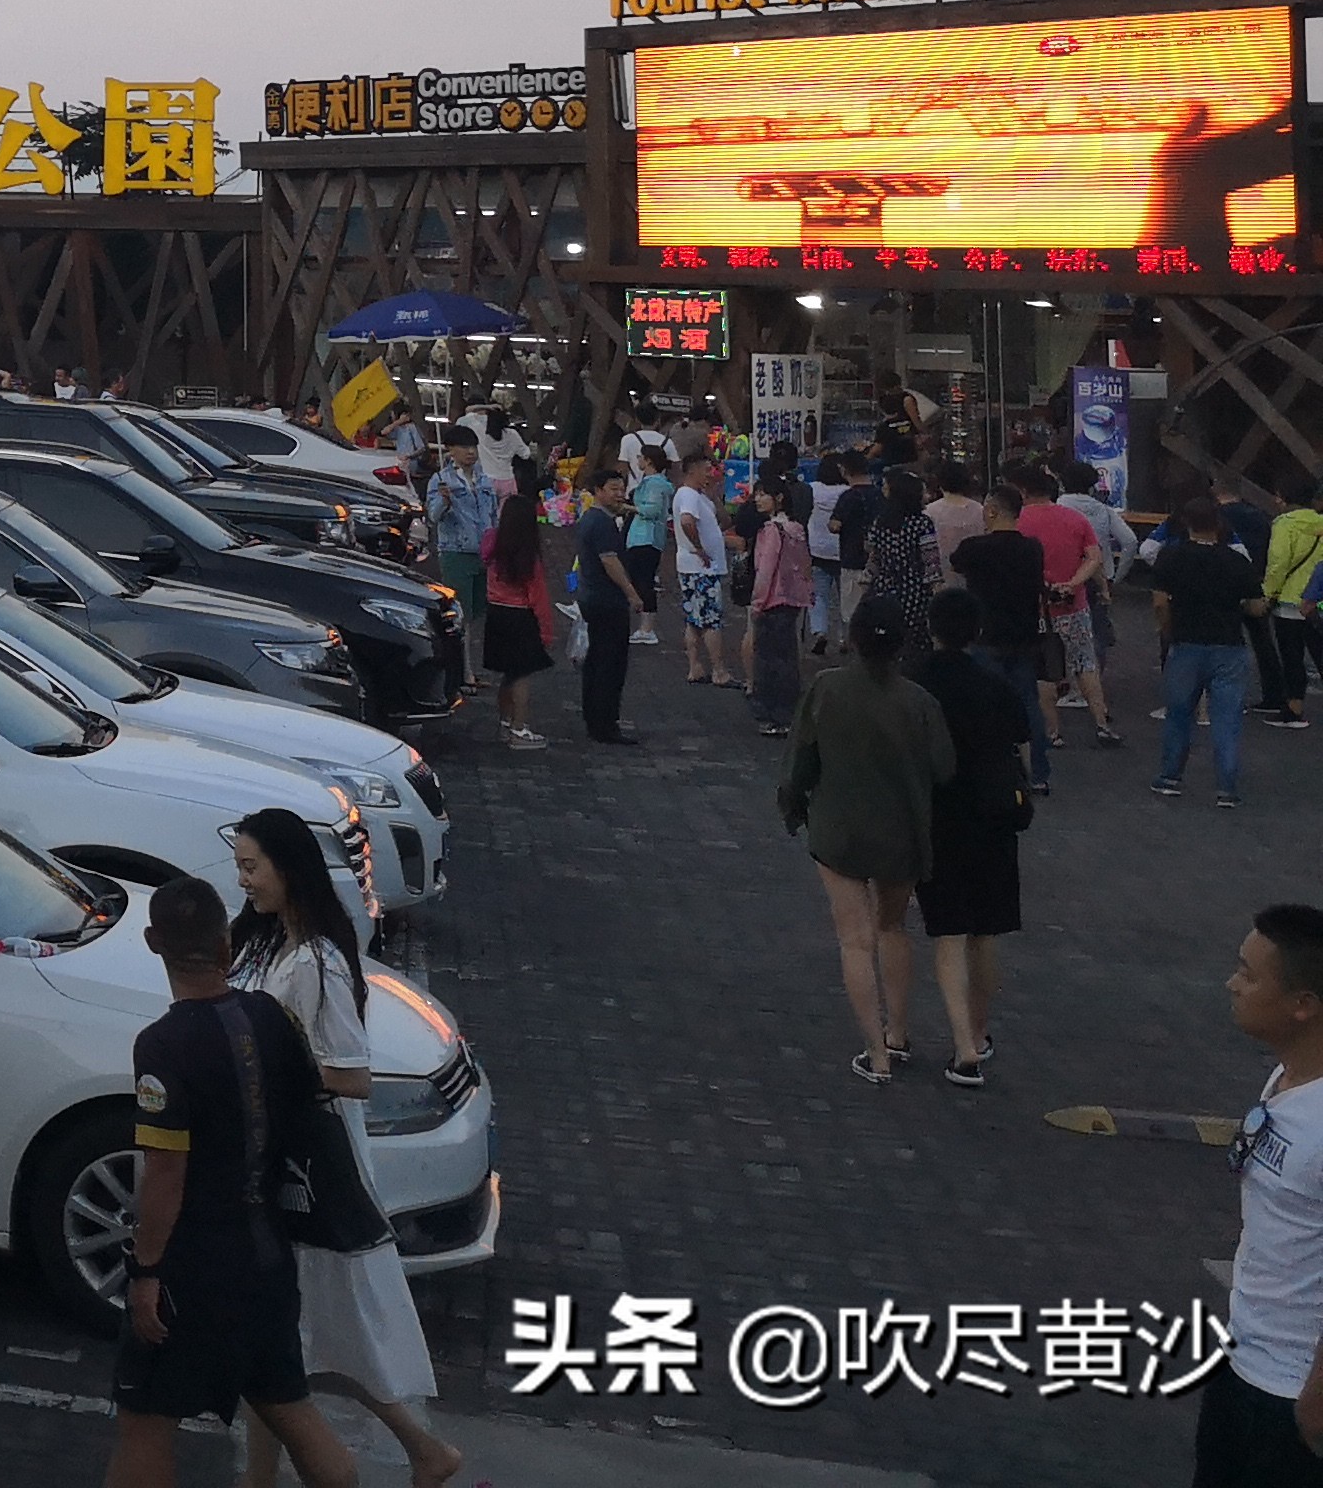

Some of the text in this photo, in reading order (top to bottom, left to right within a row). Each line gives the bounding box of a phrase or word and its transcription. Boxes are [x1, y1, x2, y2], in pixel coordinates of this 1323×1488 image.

[417, 68, 585, 99] Convenience
[283, 75, 415, 134] 便利店
[419, 102, 494, 130] Store
[630, 297, 721, 324] 北戴河特产
[1078, 381, 1123, 398] 百岁山
